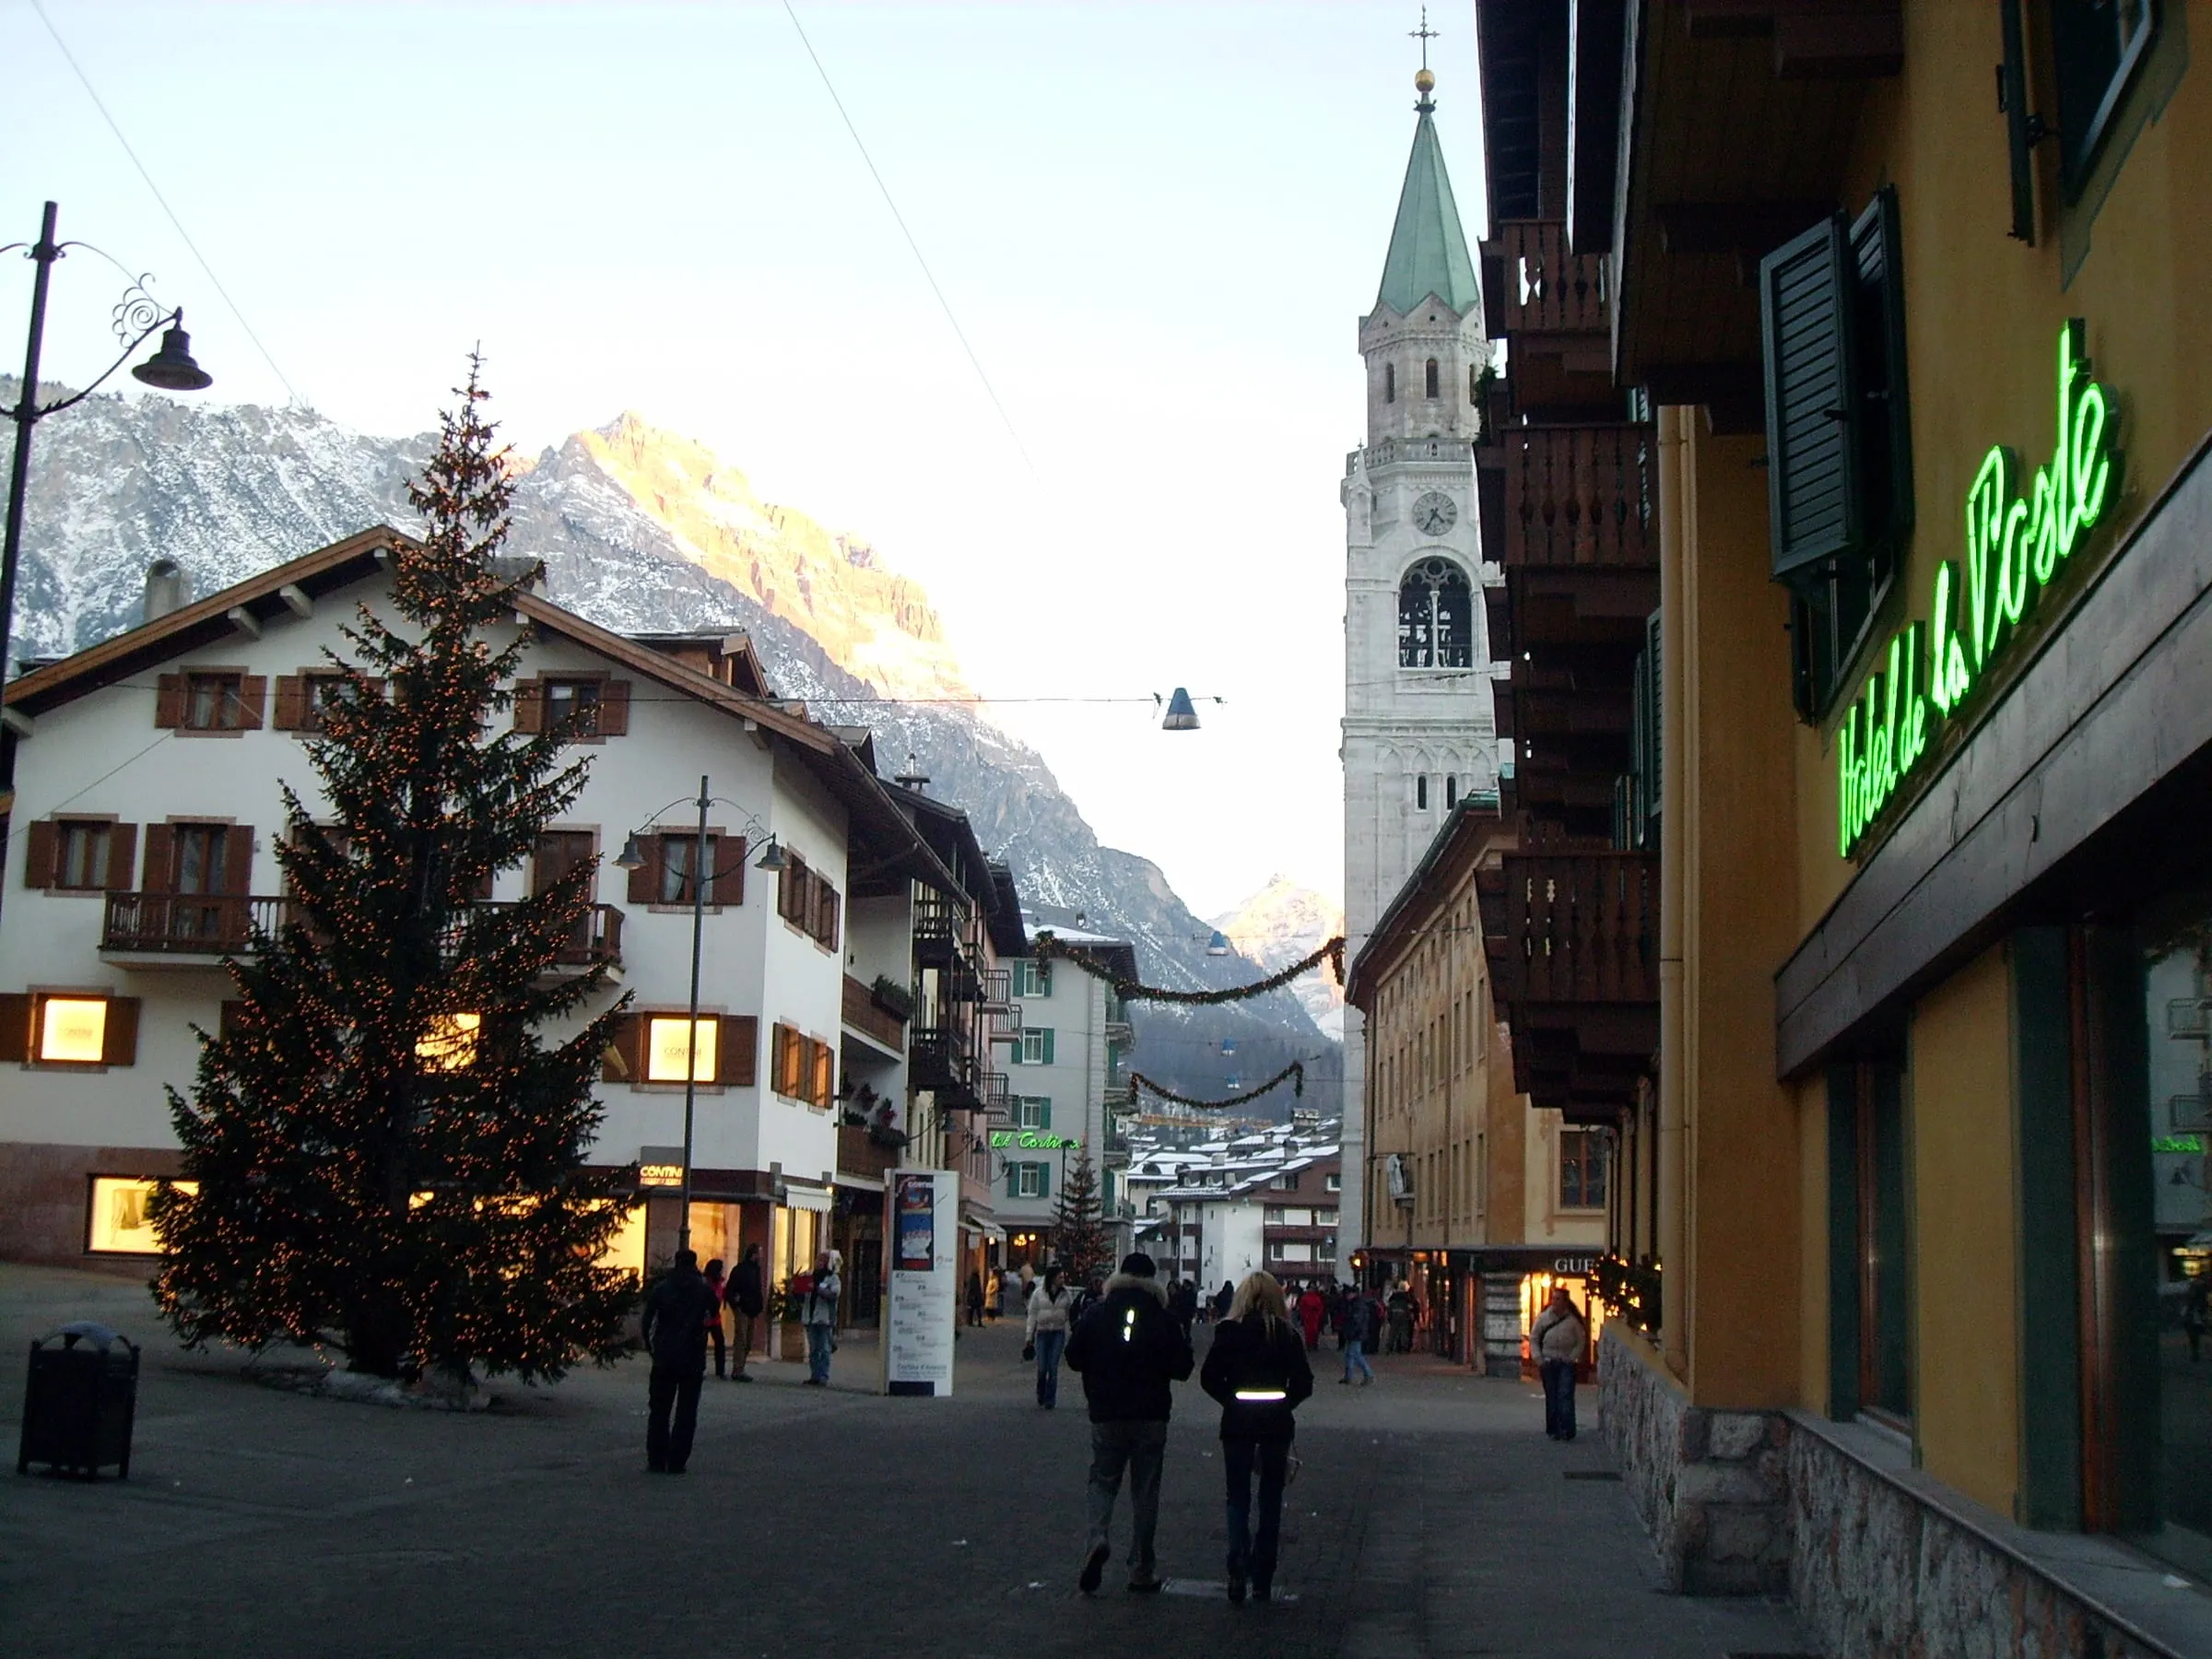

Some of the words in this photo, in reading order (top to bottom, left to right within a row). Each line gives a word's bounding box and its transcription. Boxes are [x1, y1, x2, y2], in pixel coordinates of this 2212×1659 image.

[1841, 635, 1900, 857] Hotel
[1900, 621, 1925, 774] de
[1932, 559, 1970, 718] la
[1966, 320, 2110, 673] Poste
